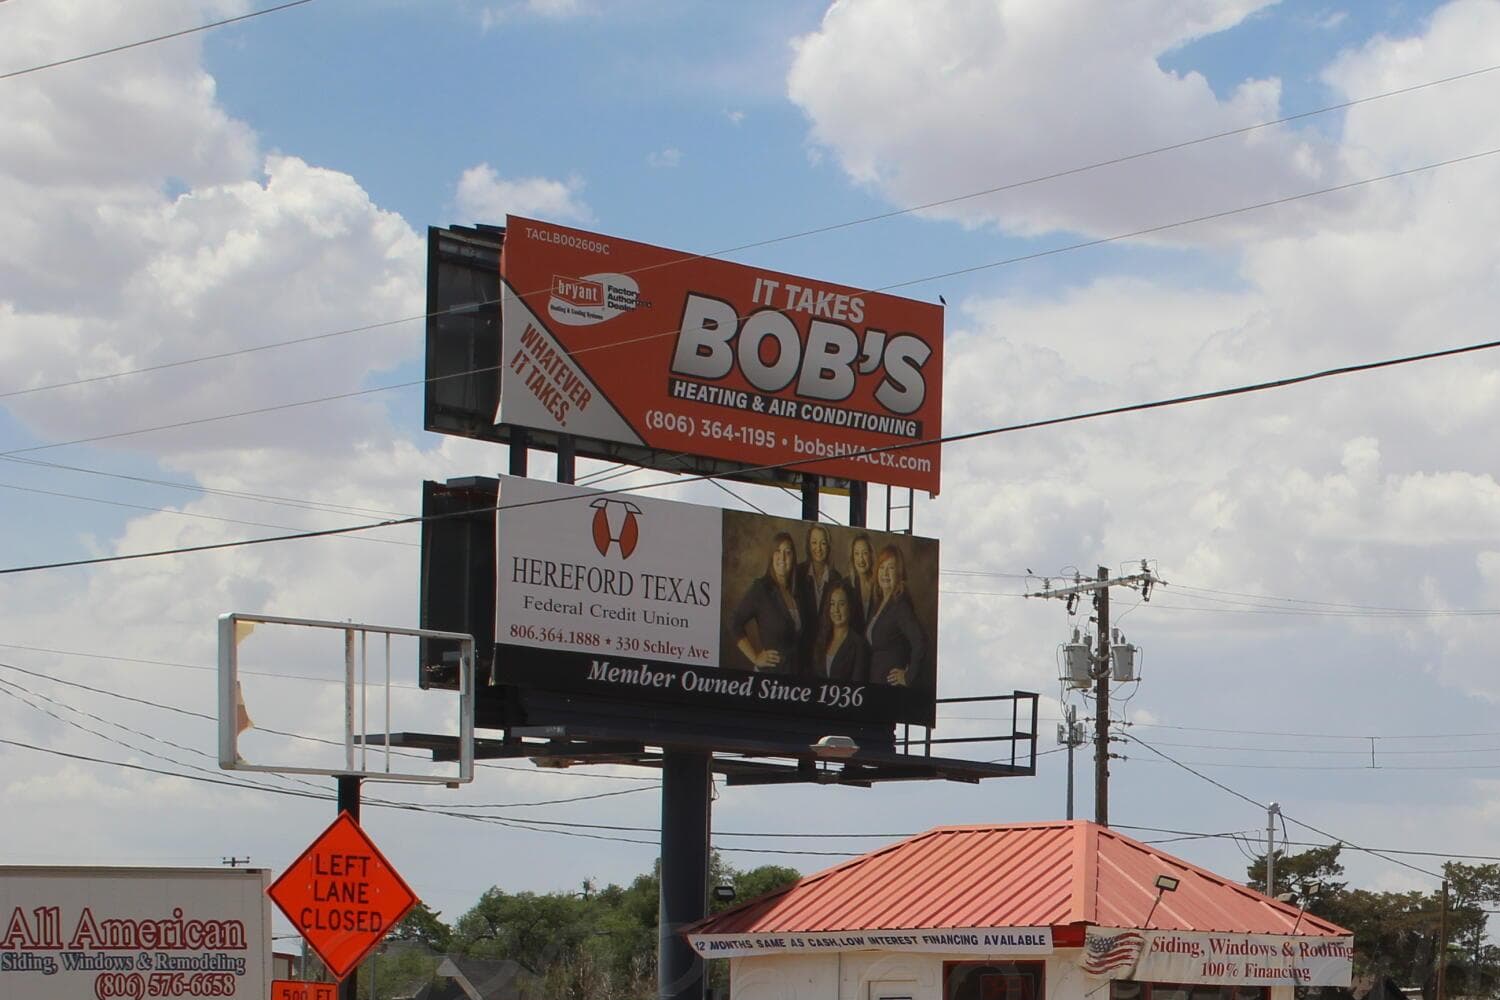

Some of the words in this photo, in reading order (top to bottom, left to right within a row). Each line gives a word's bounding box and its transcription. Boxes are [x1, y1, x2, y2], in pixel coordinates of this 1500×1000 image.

[558, 279, 598, 302] bryant
[607, 284, 641, 300] Factory
[752, 277, 780, 306] IT
[784, 283, 866, 324] TAKES
[520, 322, 593, 412] WHATEVER
[670, 290, 934, 416] BOB'S
[510, 349, 530, 375] IT
[524, 364, 570, 428] TAKES.
[673, 380, 748, 409] HEATING
[751, 396, 764, 413] &
[768, 398, 798, 418] AIR
[800, 404, 917, 438] CONDITIONING
[645, 409, 696, 437] (806)
[700, 418, 777, 449] 364-1195
[793, 434, 932, 473] bobsHVACtx.com
[511, 556, 634, 597] HEREFORD
[640, 573, 711, 608] TEXAS
[522, 595, 584, 616] Federal
[589, 604, 637, 623] Credit
[642, 610, 690, 629] Union
[509, 623, 601, 648] 806.364.1888
[615, 635, 641, 652] 330
[642, 639, 686, 660] Schley
[687, 645, 711, 660] Ave
[586, 659, 676, 690] Member
[680, 670, 753, 698] Owned
[757, 677, 813, 703] Since
[816, 684, 866, 708] 1936
[314, 853, 371, 878] LEFT
[313, 880, 369, 904] LANE
[0, 906, 63, 951] All
[68, 907, 248, 951] American
[300, 907, 382, 933] CLOSED
[695, 941, 705, 951] 12
[710, 940, 752, 950] MONTHS
[756, 938, 785, 948] SAME
[791, 939, 804, 948] AS
[867, 936, 917, 946] INTEREST
[922, 935, 979, 946] FINANCING
[984, 935, 1046, 946] AVAILABLE
[1151, 935, 1205, 957] Siding,
[1209, 938, 1278, 957] Windows
[1281, 941, 1295, 957] &
[1299, 941, 1353, 961] Roofing
[1, 952, 58, 975] Siding,
[60, 952, 134, 972] Windows
[135, 953, 152, 971] &
[154, 953, 246, 975] Remodeling
[1201, 962, 1239, 978] 100%
[1244, 962, 1311, 981] Financing
[147, 973, 236, 997] 576-6658
